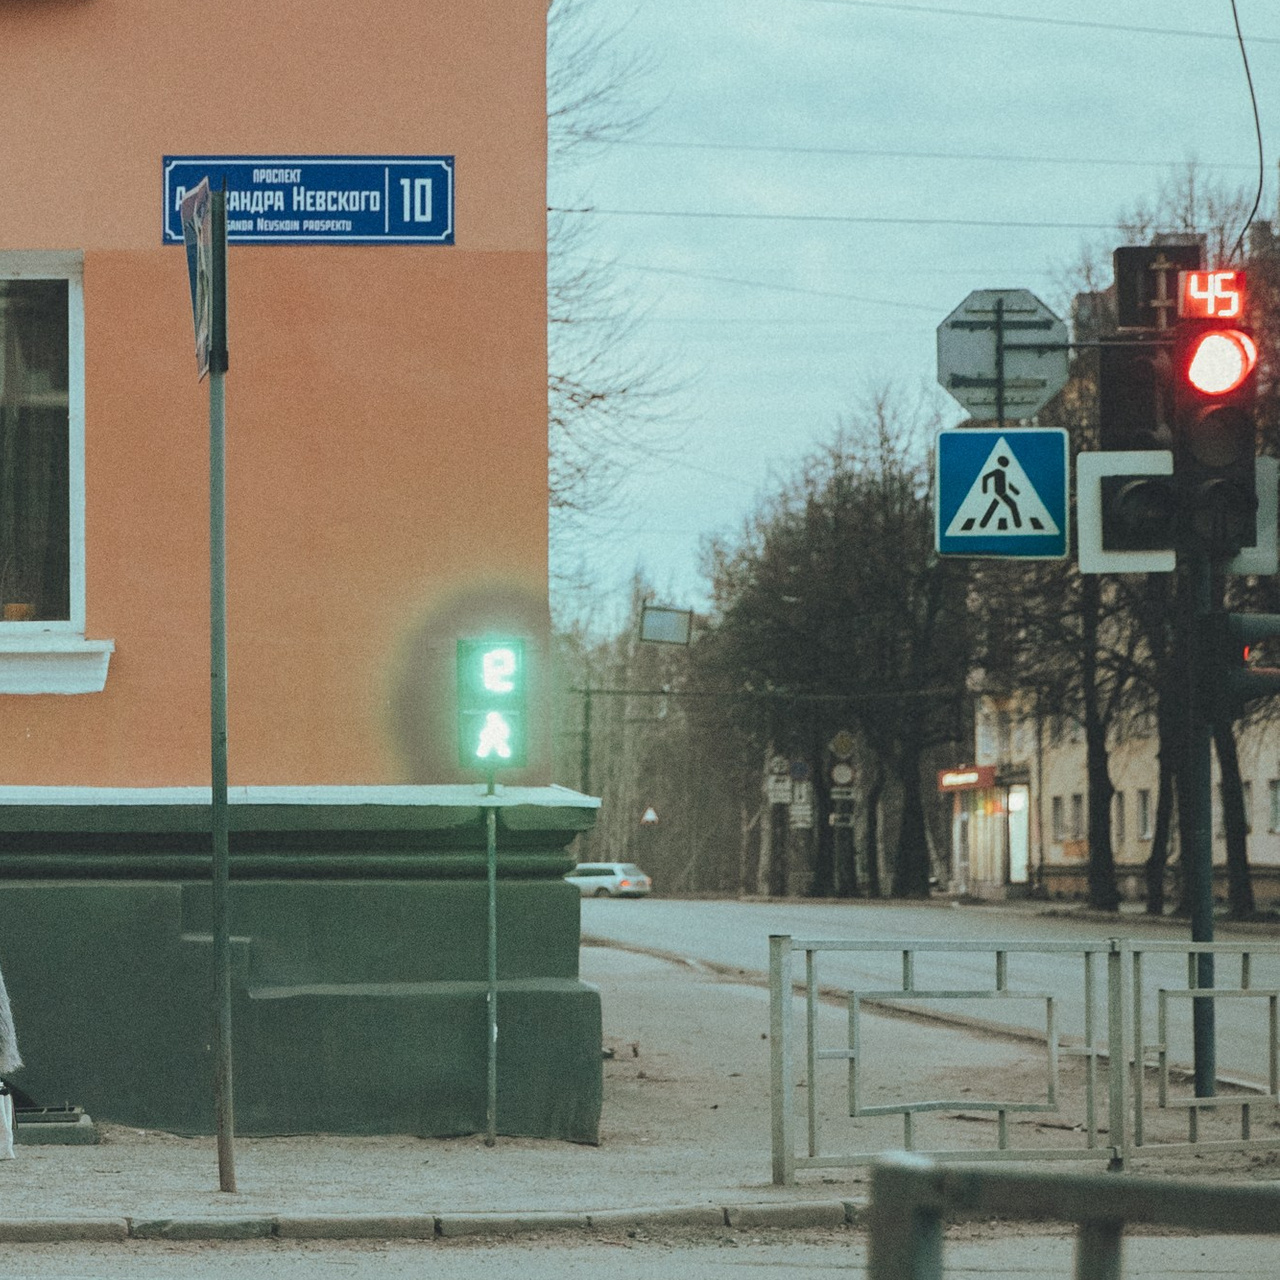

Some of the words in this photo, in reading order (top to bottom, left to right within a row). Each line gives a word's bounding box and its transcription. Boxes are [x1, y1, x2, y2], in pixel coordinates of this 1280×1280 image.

[252, 168, 302, 184] ПРОСПЕКТ
[400, 178, 432, 222] 10
[1190, 272, 1239, 317] 45
